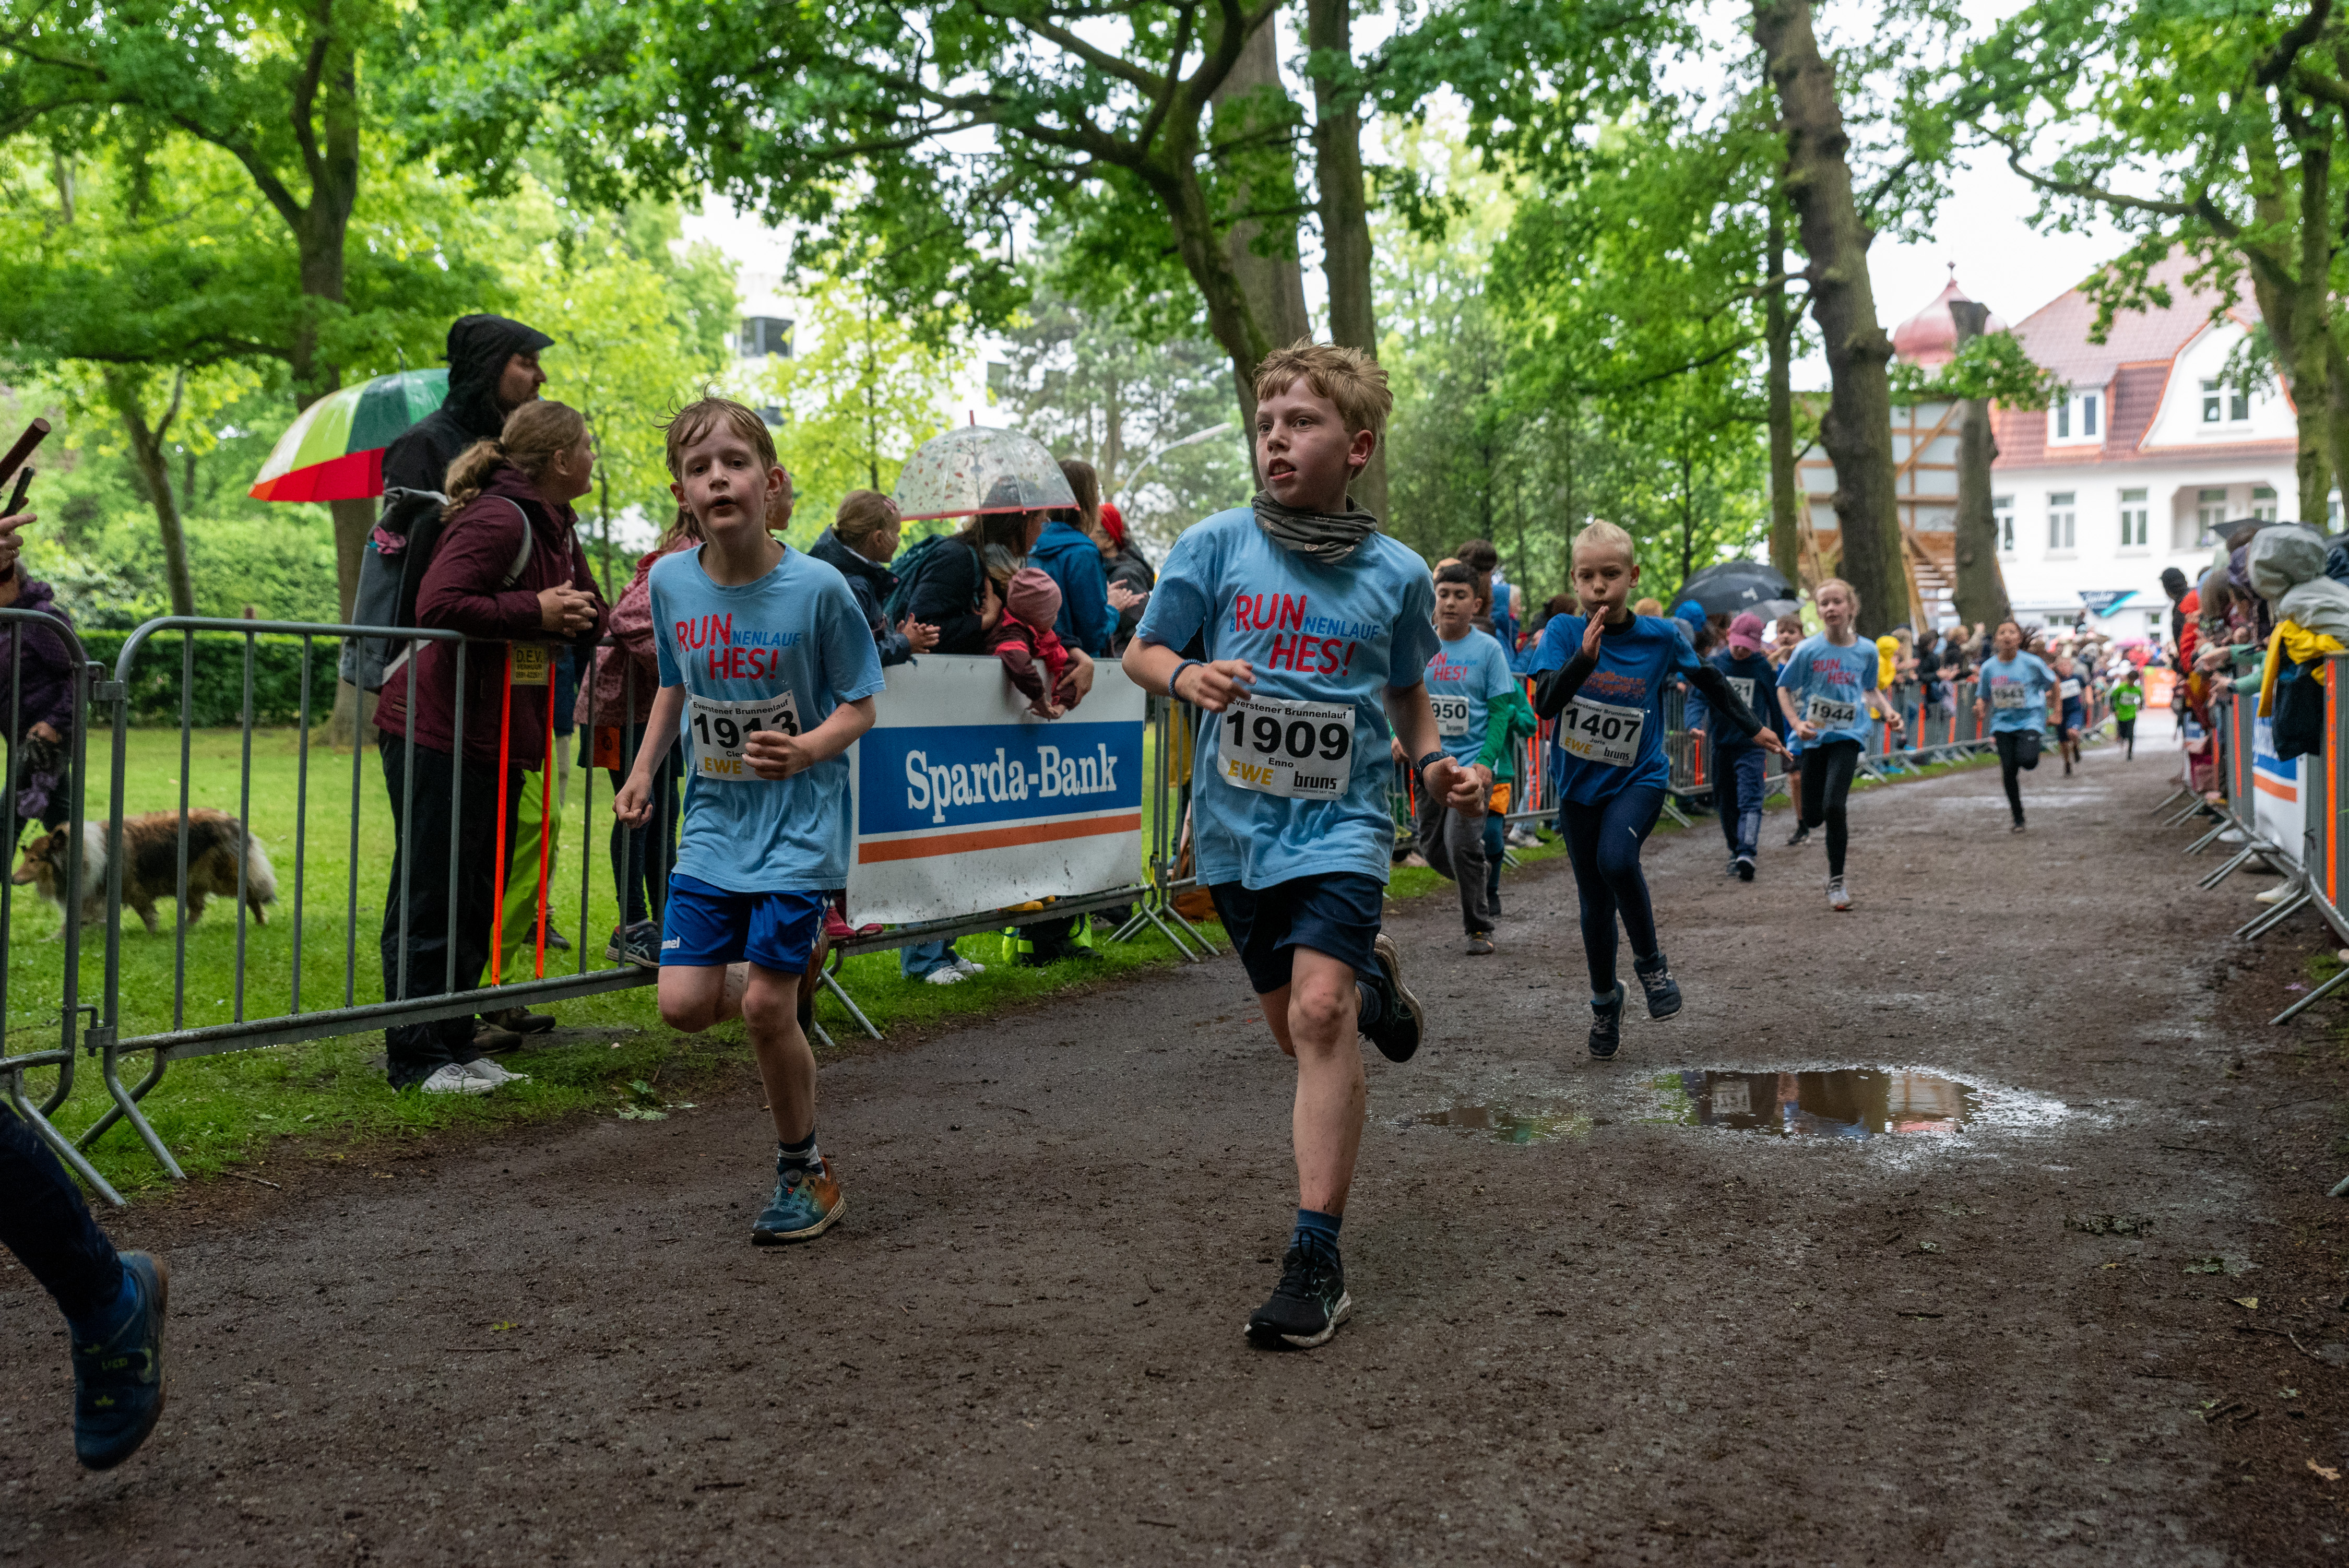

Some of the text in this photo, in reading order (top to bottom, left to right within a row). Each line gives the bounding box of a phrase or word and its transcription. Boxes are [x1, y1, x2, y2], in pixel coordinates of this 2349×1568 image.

[709, 647, 778, 680] HES!
[1268, 634, 1356, 676] HES!
[1433, 666, 1468, 681] HES!
[693, 698, 789, 715] Everstener Brunnenlauf
[1285, 707, 1347, 719] Brunnenlauf
[1432, 703, 1467, 719] 950
[1811, 703, 1854, 722] 1944
[1566, 707, 1641, 742] 1407
[1226, 710, 1349, 761] 1909
[1564, 737, 1592, 754] EWE
[1604, 747, 1630, 761] bruns
[705, 757, 742, 774] EWE
[1268, 757, 1294, 768] Enno
[1228, 759, 1274, 786] EWE
[1293, 771, 1337, 790] bruns
[905, 743, 1118, 823] Sparda-Bank
